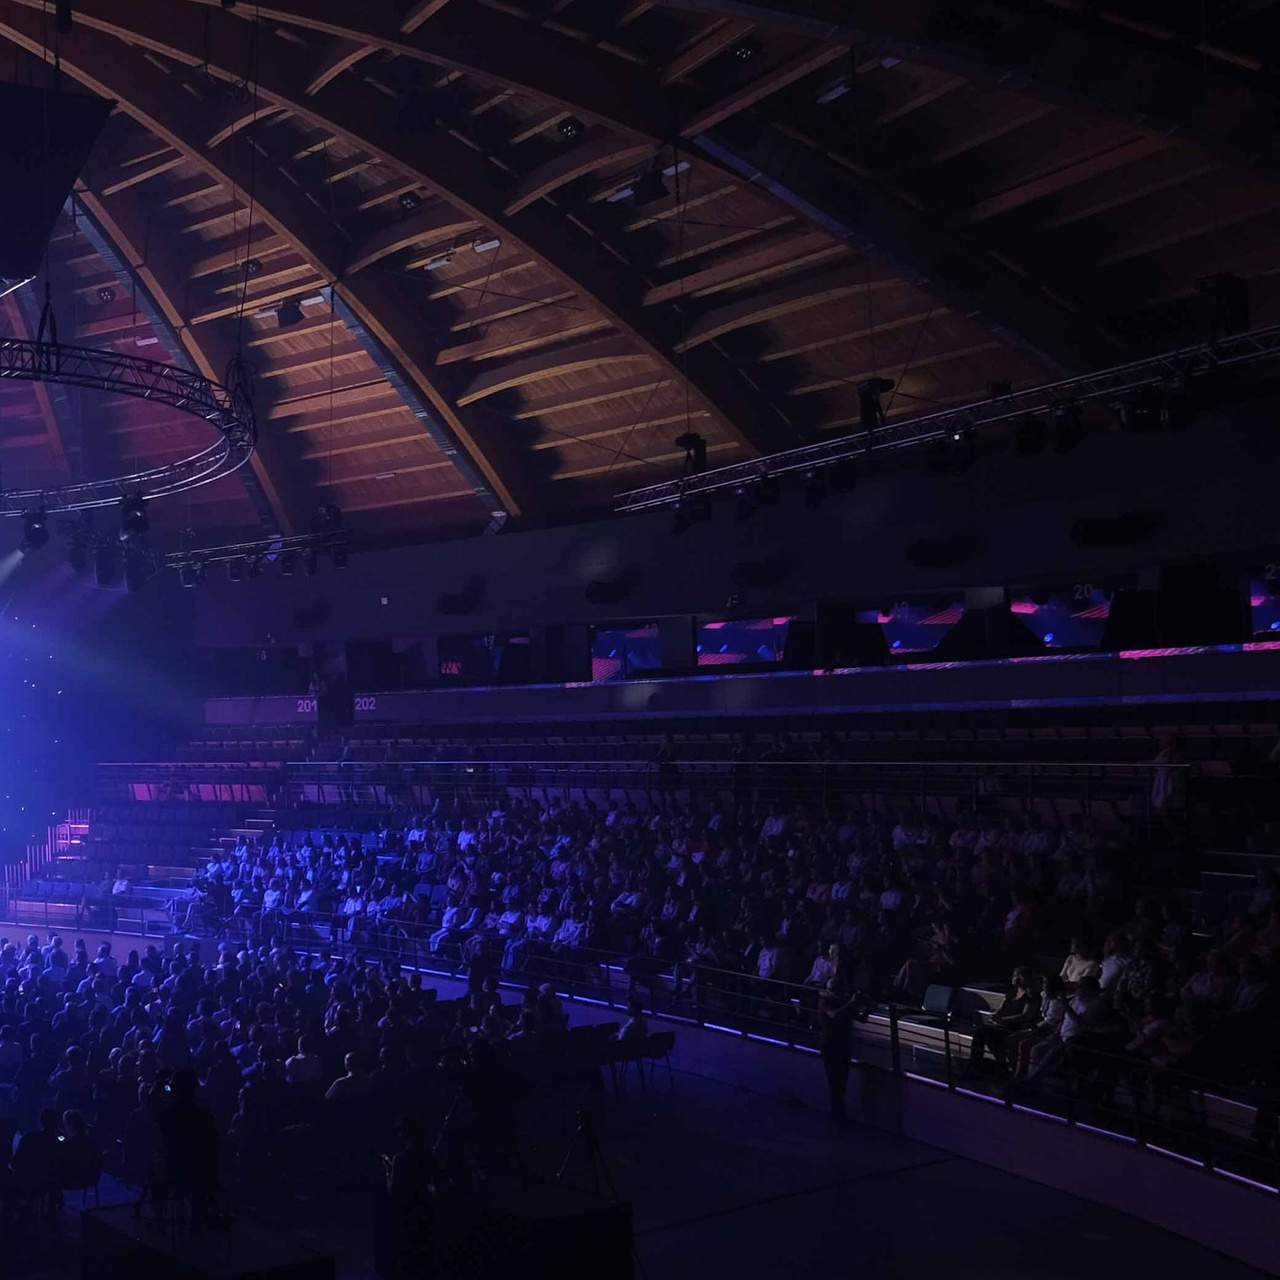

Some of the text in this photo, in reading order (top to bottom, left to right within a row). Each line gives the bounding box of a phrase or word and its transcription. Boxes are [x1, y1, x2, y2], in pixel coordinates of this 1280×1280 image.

[1265, 563, 1280, 580] 2
[1073, 583, 1093, 599] 20
[297, 700, 318, 712] 201
[354, 697, 376, 710] 202
